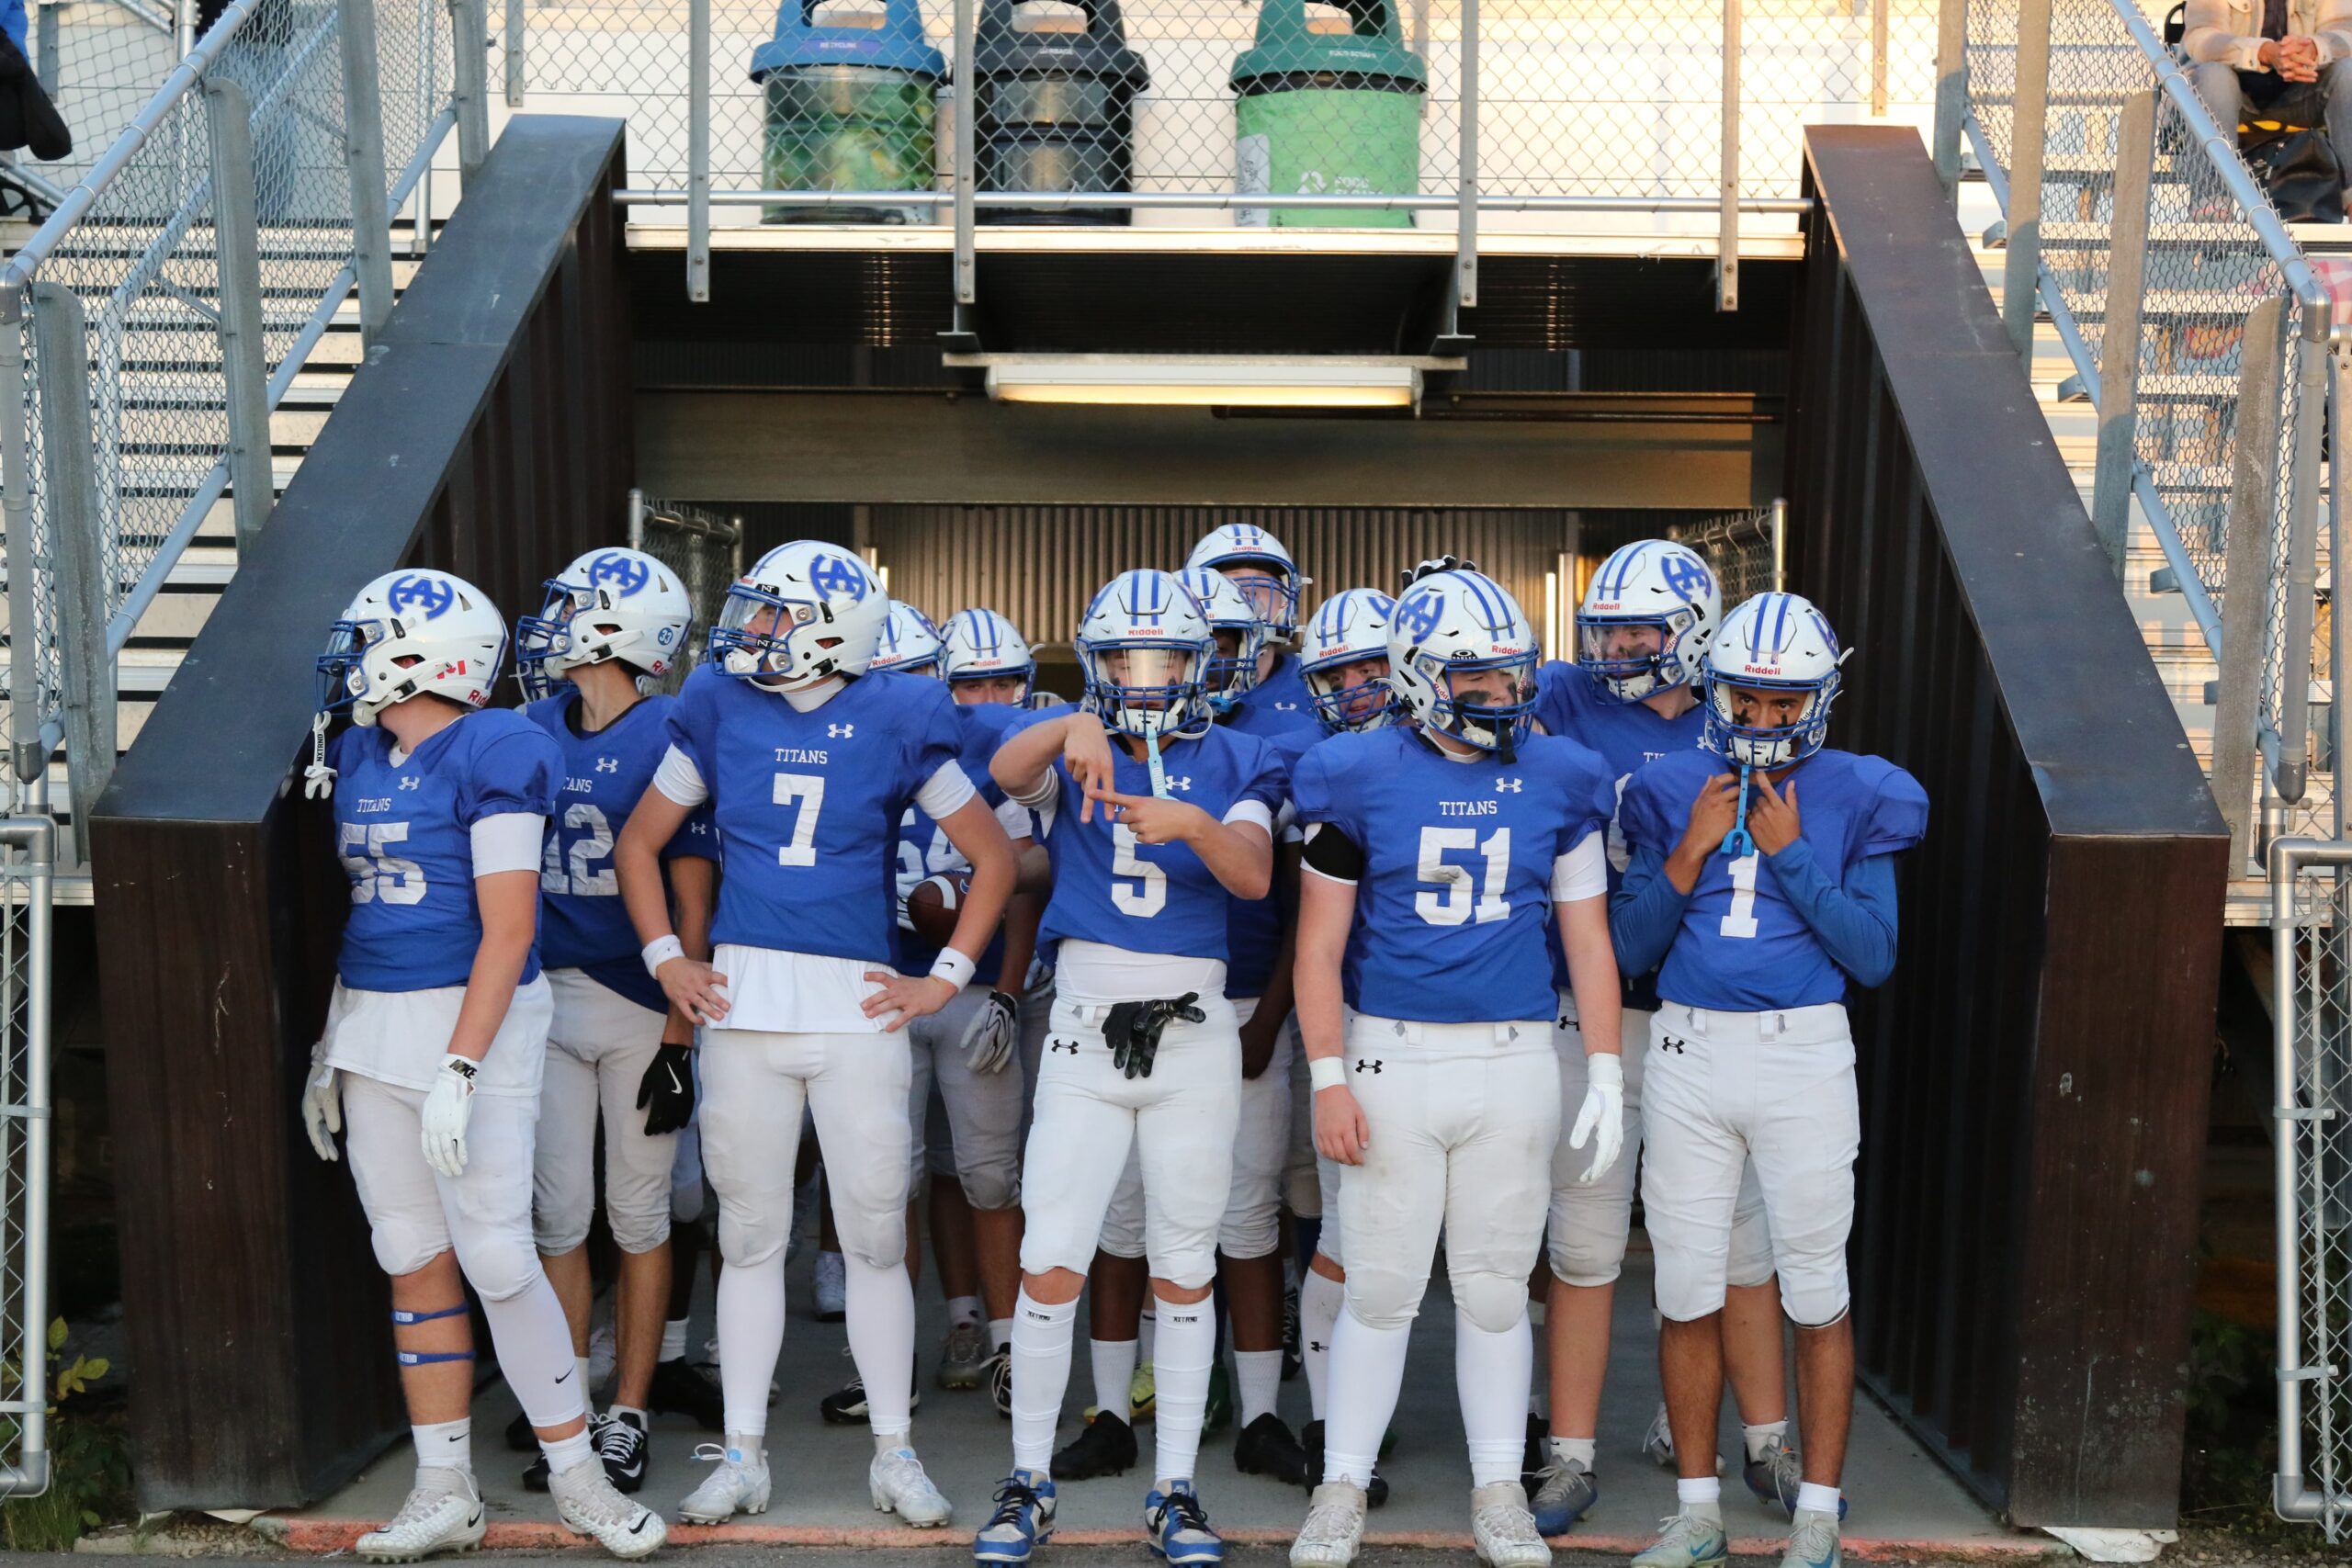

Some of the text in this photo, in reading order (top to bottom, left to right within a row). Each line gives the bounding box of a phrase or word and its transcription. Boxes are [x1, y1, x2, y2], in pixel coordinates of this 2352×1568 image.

[872, 654, 902, 667] Riddell
[1319, 645, 1349, 659] Riddell
[1745, 664, 1781, 675] Riddell
[316, 734, 324, 762] NXTRND
[775, 749, 828, 764] TITANS
[356, 797, 391, 813] TITANS
[1439, 800, 1498, 816] TITANS
[773, 773, 825, 866] 7
[337, 821, 427, 905] 55
[541, 803, 619, 897] 12
[1111, 823, 1167, 919] 5
[1415, 826, 1510, 925] 51
[1720, 849, 1758, 938] 1
